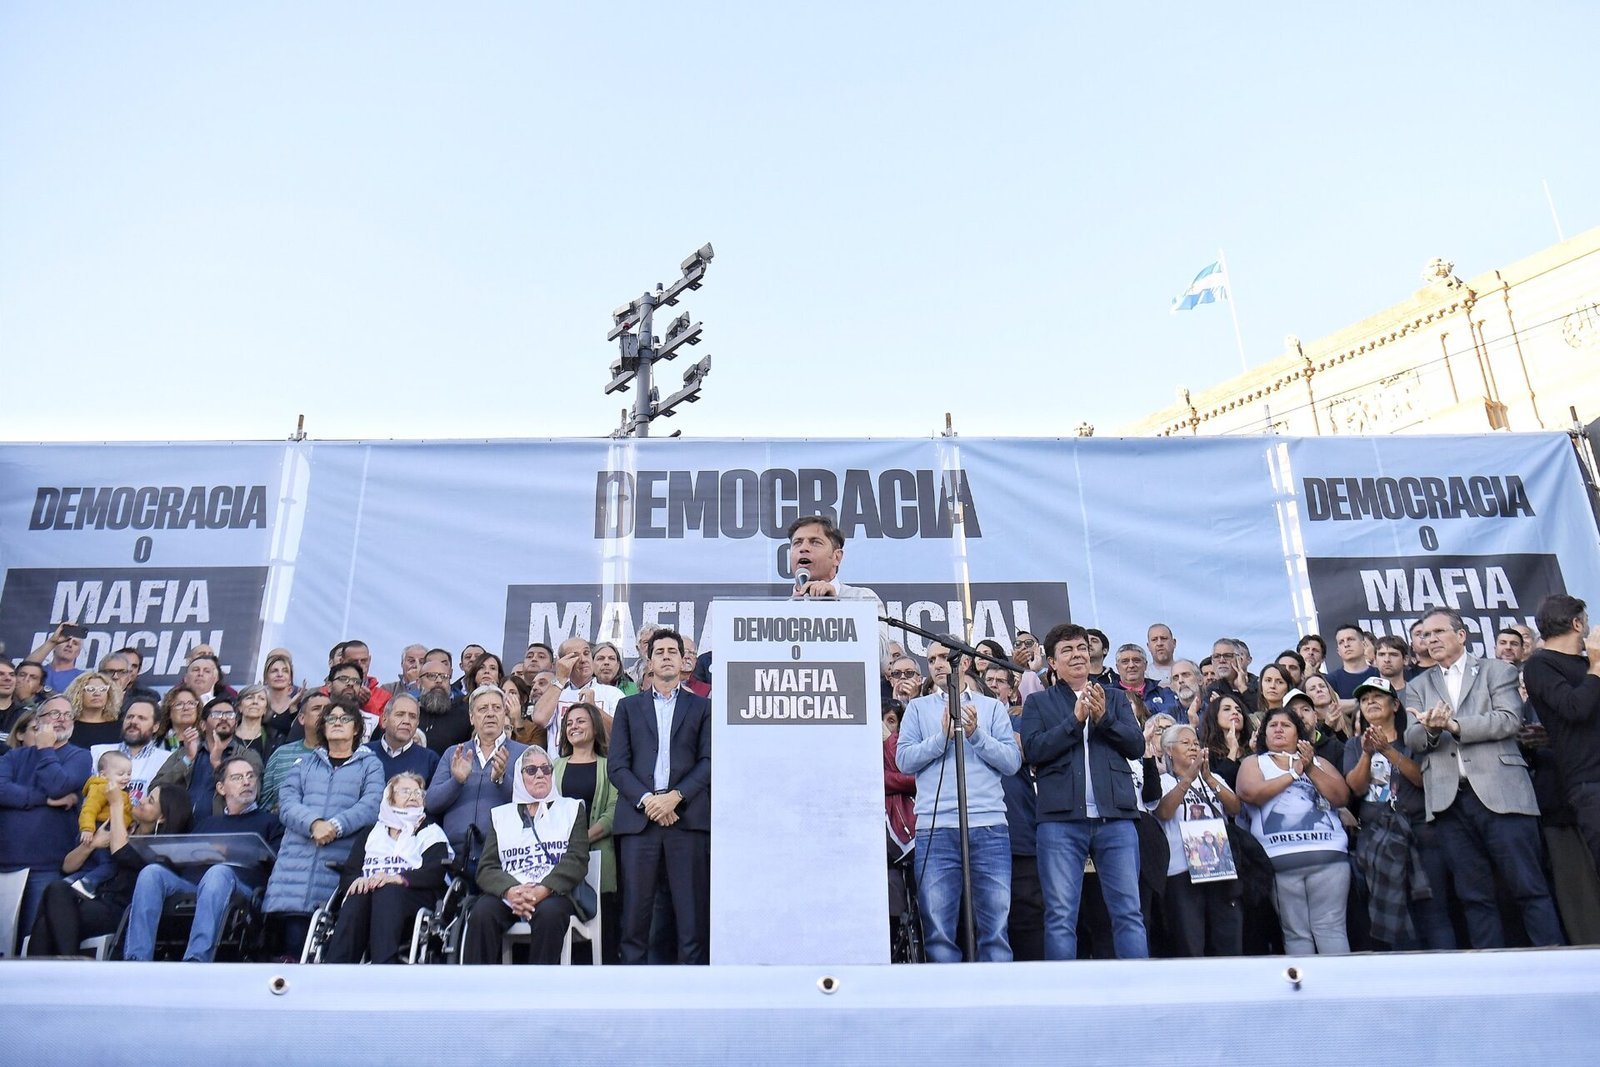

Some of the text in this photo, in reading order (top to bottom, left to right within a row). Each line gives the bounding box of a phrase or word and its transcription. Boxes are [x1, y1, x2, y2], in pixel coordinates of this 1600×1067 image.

[29, 485, 267, 531] DEMOCRACIA
[594, 468, 982, 539] DEMOCRACIA
[1303, 475, 1536, 521] DEMOCRACIA
[133, 536, 153, 563] O
[1419, 525, 1440, 551] O
[1360, 566, 1519, 612] MAFIA
[49, 580, 210, 625] MAFIA
[733, 617, 858, 642] DEMOCRACIA
[791, 644, 801, 660] O
[754, 668, 838, 692] MAFIA
[740, 695, 854, 719] JUDICIAL
[501, 840, 568, 860] TODOS SOMOS
